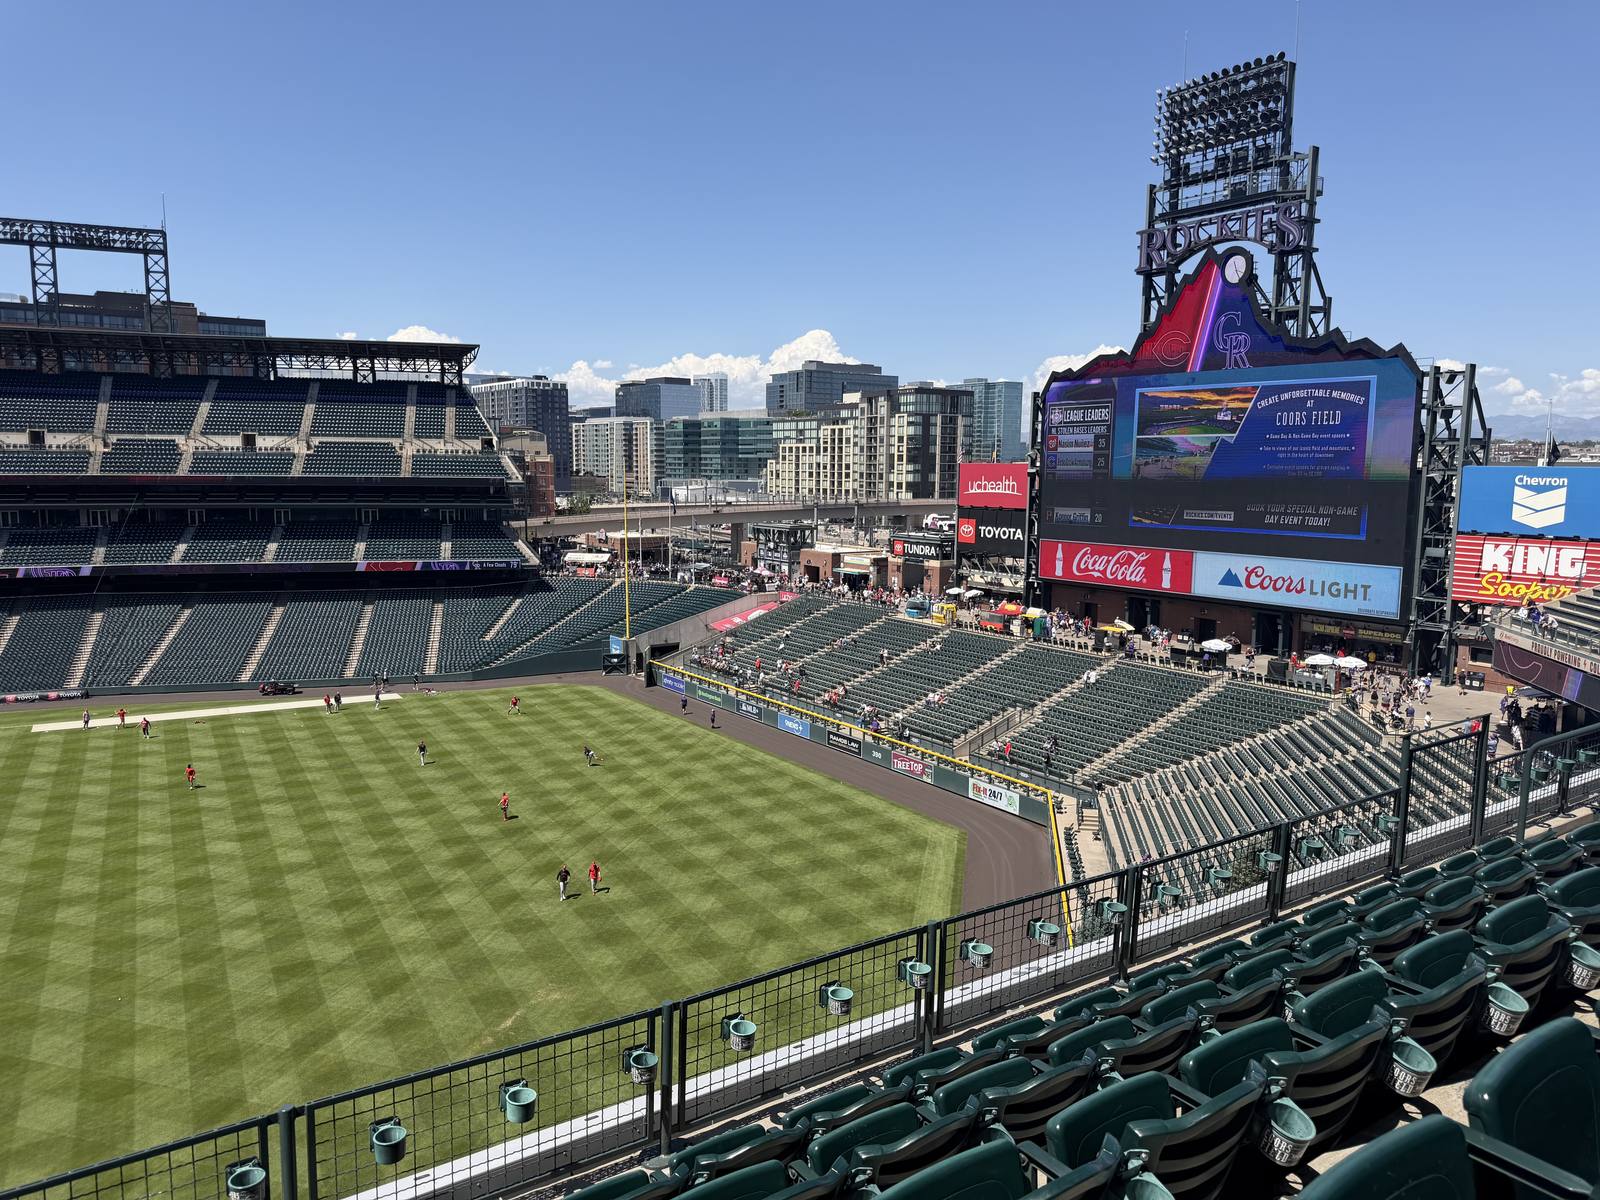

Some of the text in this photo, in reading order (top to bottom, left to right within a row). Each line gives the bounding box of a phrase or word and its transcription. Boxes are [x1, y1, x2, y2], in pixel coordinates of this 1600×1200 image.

[1136, 201, 1305, 271] ROCKIES
[1257, 389, 1365, 408] CREATE UNFORGETTABLE MEMORIES
[1306, 400, 1314, 408] AT
[1064, 408, 1109, 422] LEAGUE LEADERS
[1276, 410, 1341, 426] COORS FIELD
[1074, 426, 1087, 434] BASES
[1088, 426, 1107, 434] LEADERS
[1098, 439, 1106, 448] 35
[1097, 458, 1104, 466] 25
[968, 476, 1017, 493] uchealth
[1514, 474, 1568, 486] Chevron
[1267, 504, 1285, 513] YOUR
[1287, 505, 1317, 514] SPECIAL
[1318, 506, 1358, 516] NON-GAME
[1094, 513, 1103, 522] 20
[1265, 515, 1331, 526] DAY EVENT TODAY!
[978, 526, 1024, 540] TOYOTA
[904, 544, 936, 556] TUNDRA
[1072, 547, 1152, 582] Coca-Cola
[1481, 543, 1587, 577] KING
[1245, 566, 1372, 600] Coors LIGHT
[1532, 642, 1552, 658] PROUDLY
[1554, 651, 1581, 667] POWERING
[829, 734, 848, 744] RAMOS
[848, 740, 858, 748] LAW
[872, 750, 882, 759] 390
[988, 789, 1002, 801] 24/7
[1488, 1007, 1511, 1024] OORS
